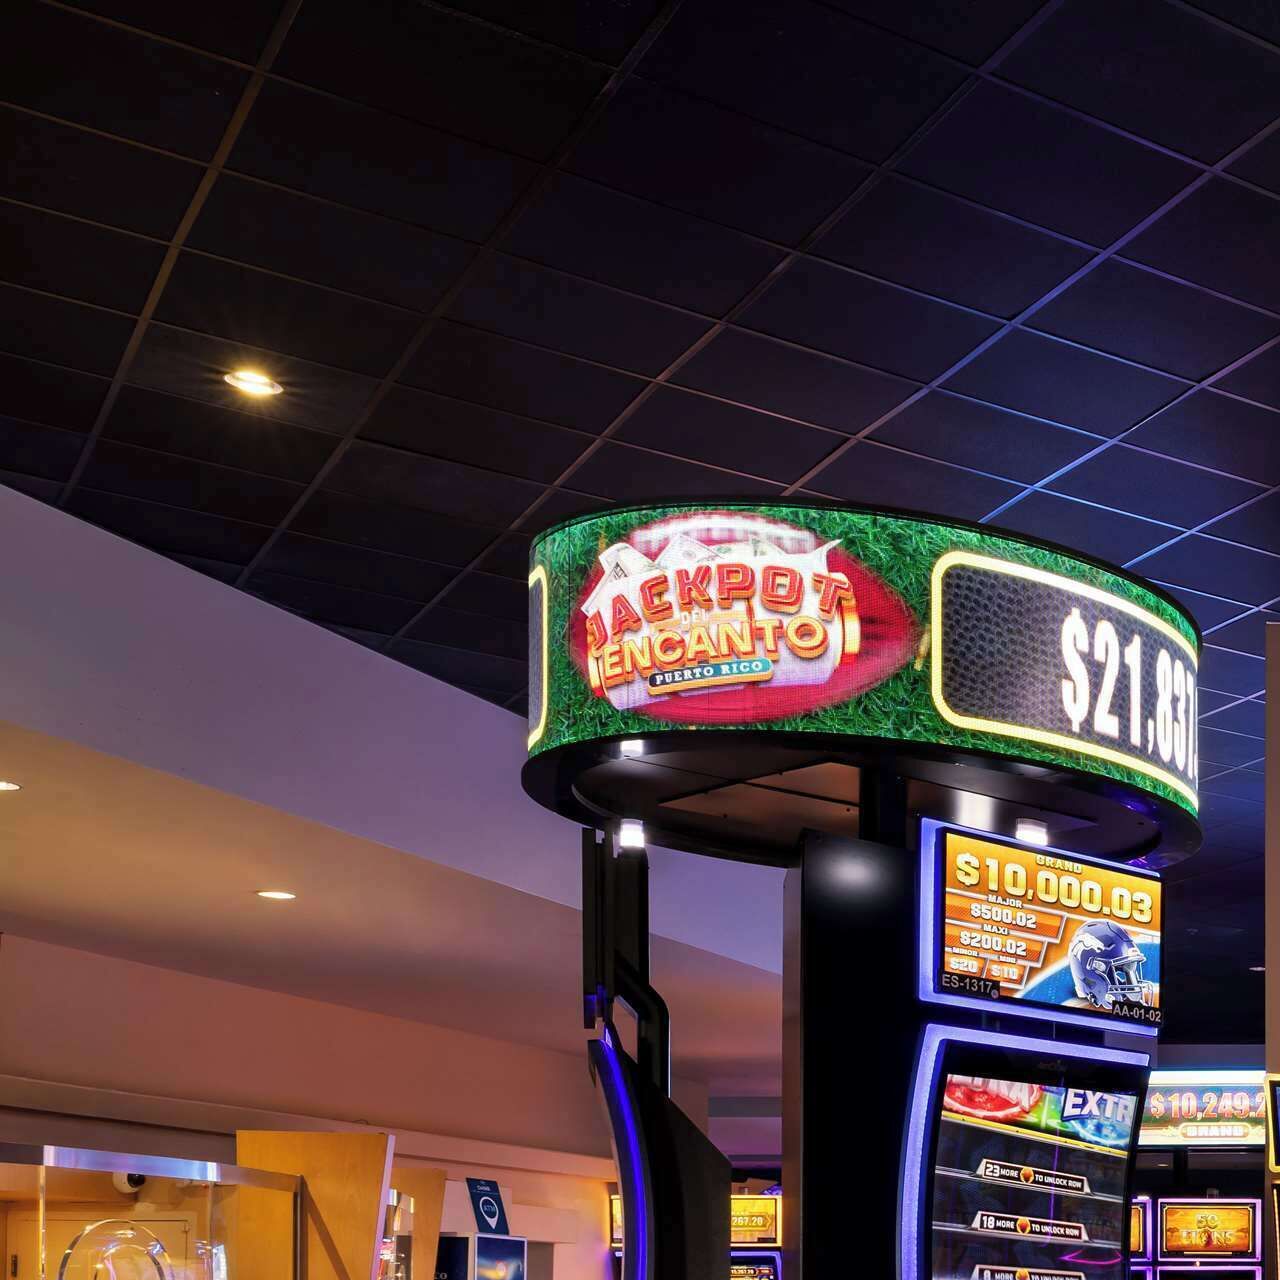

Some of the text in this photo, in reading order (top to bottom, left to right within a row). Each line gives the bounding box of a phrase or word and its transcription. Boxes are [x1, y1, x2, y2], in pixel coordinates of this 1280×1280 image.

[586, 563, 853, 656] JACKPOT
[602, 615, 828, 687] ENCANTO
[655, 660, 763, 685] PUERTO RICO
[1036, 855, 1083, 874] GRAND
[956, 853, 1152, 923] $10,000.03
[987, 894, 1023, 909] MAJOR
[970, 902, 1037, 928] $500.02
[983, 923, 1009, 935] MAXI
[960, 931, 1027, 956] $200.02
[950, 957, 978, 973] $20
[991, 965, 1018, 980] $10
[942, 974, 993, 994] ES-1317
[1113, 1004, 1162, 1023] AA-01-02
[985, 1164, 1000, 1177] 23
[1000, 1167, 1018, 1179] MORE
[1044, 1175, 1067, 1187] UNLOCK
[1067, 1179, 1082, 1189] ROW
[982, 1216, 995, 1229] 18
[996, 1218, 1014, 1229] MORE
[1041, 1224, 1065, 1235] UNLOCK
